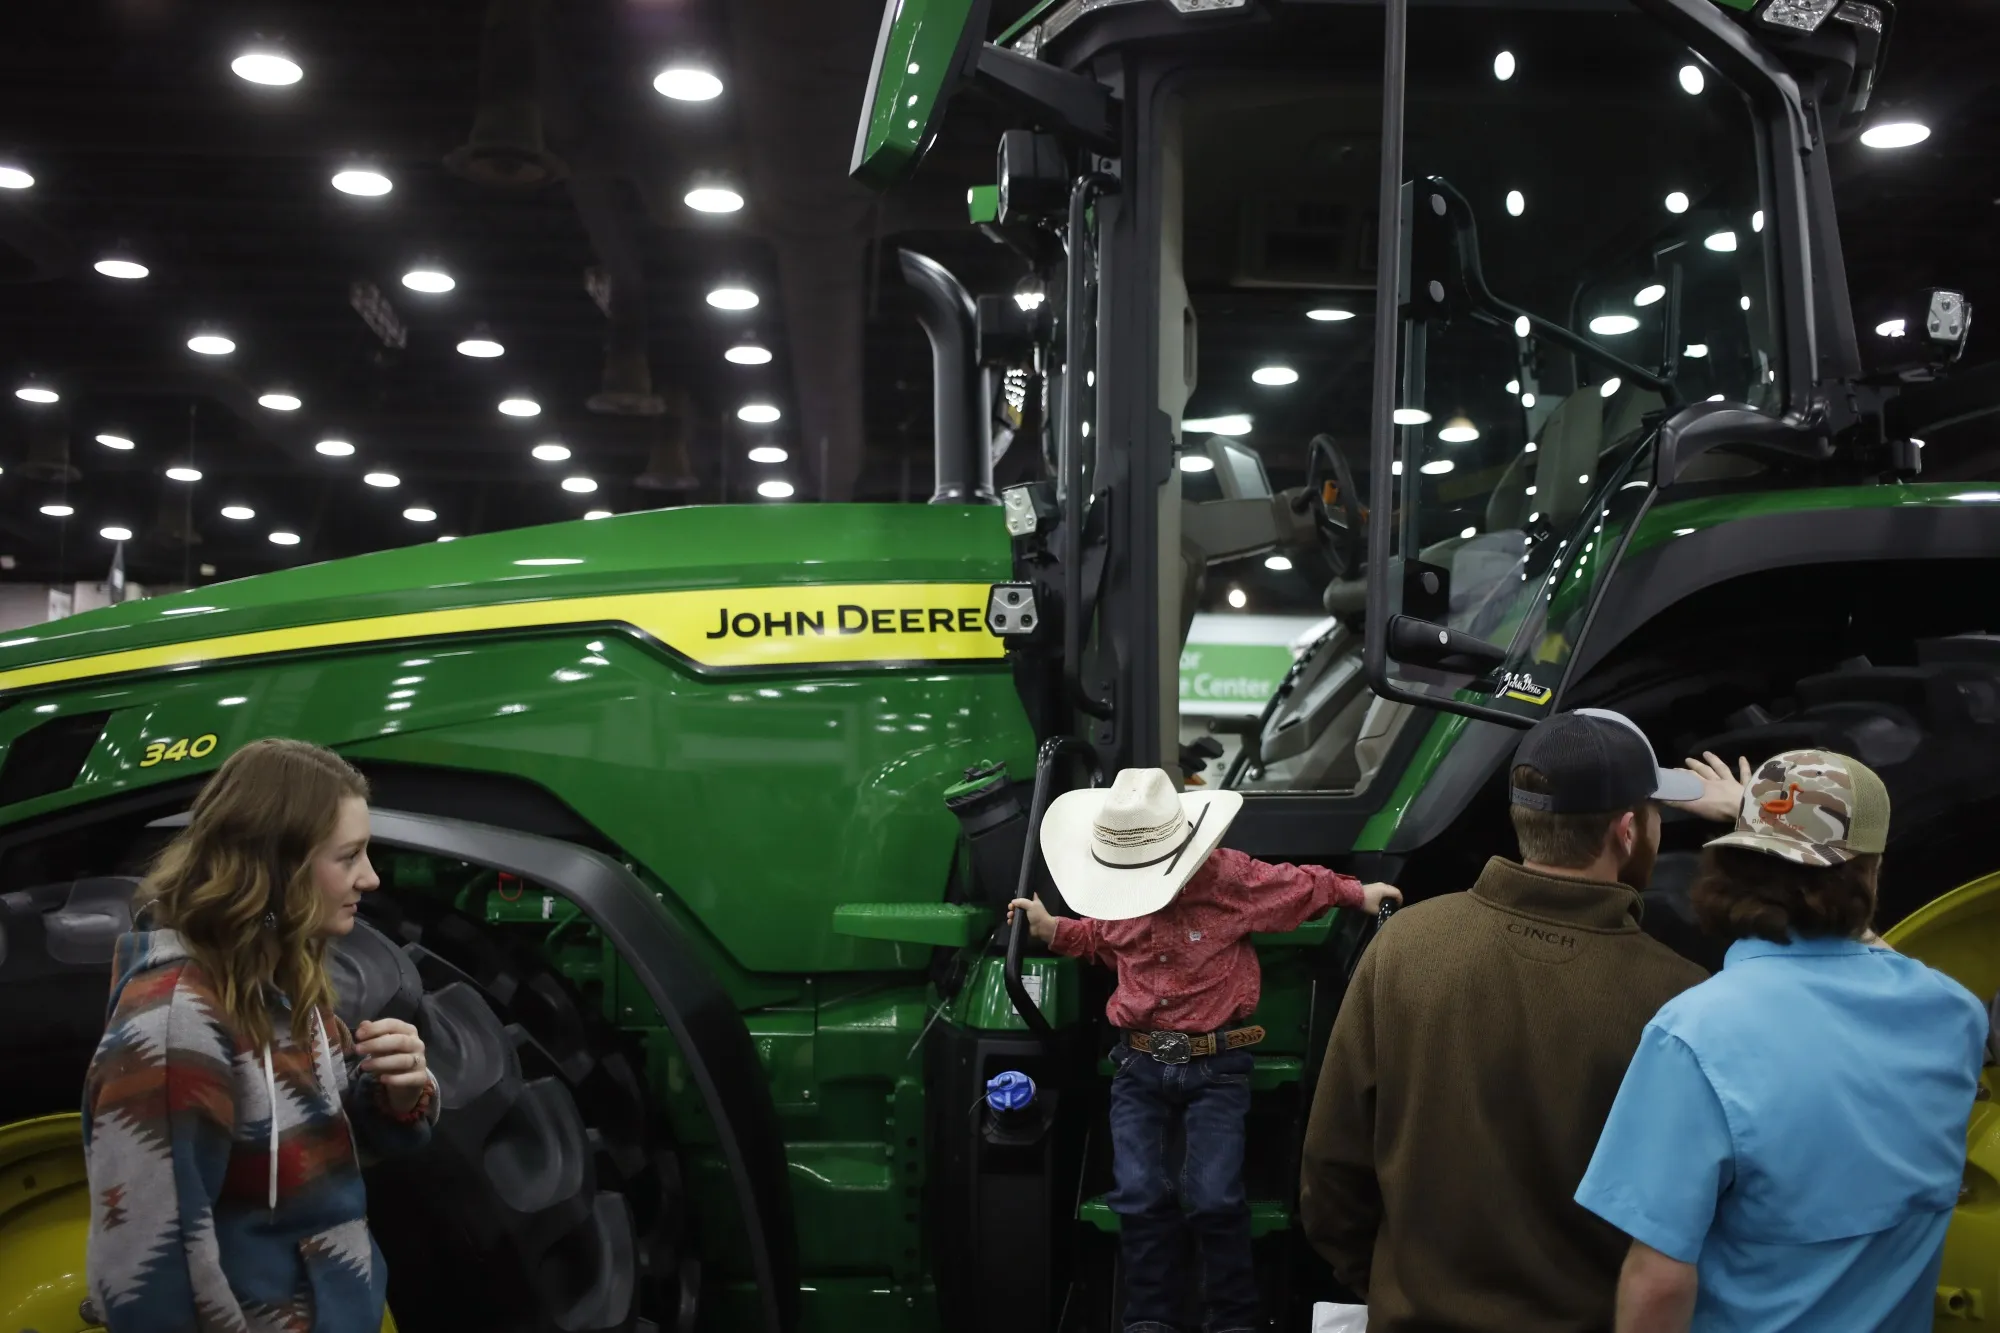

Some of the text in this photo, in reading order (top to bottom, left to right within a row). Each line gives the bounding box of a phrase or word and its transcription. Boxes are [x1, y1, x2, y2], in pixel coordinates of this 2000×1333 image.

[706, 604, 983, 639] JOHN DEERE
[1194, 673, 1270, 698] Center
[139, 732, 218, 768] 340
[1507, 923, 1576, 949] CINCH
